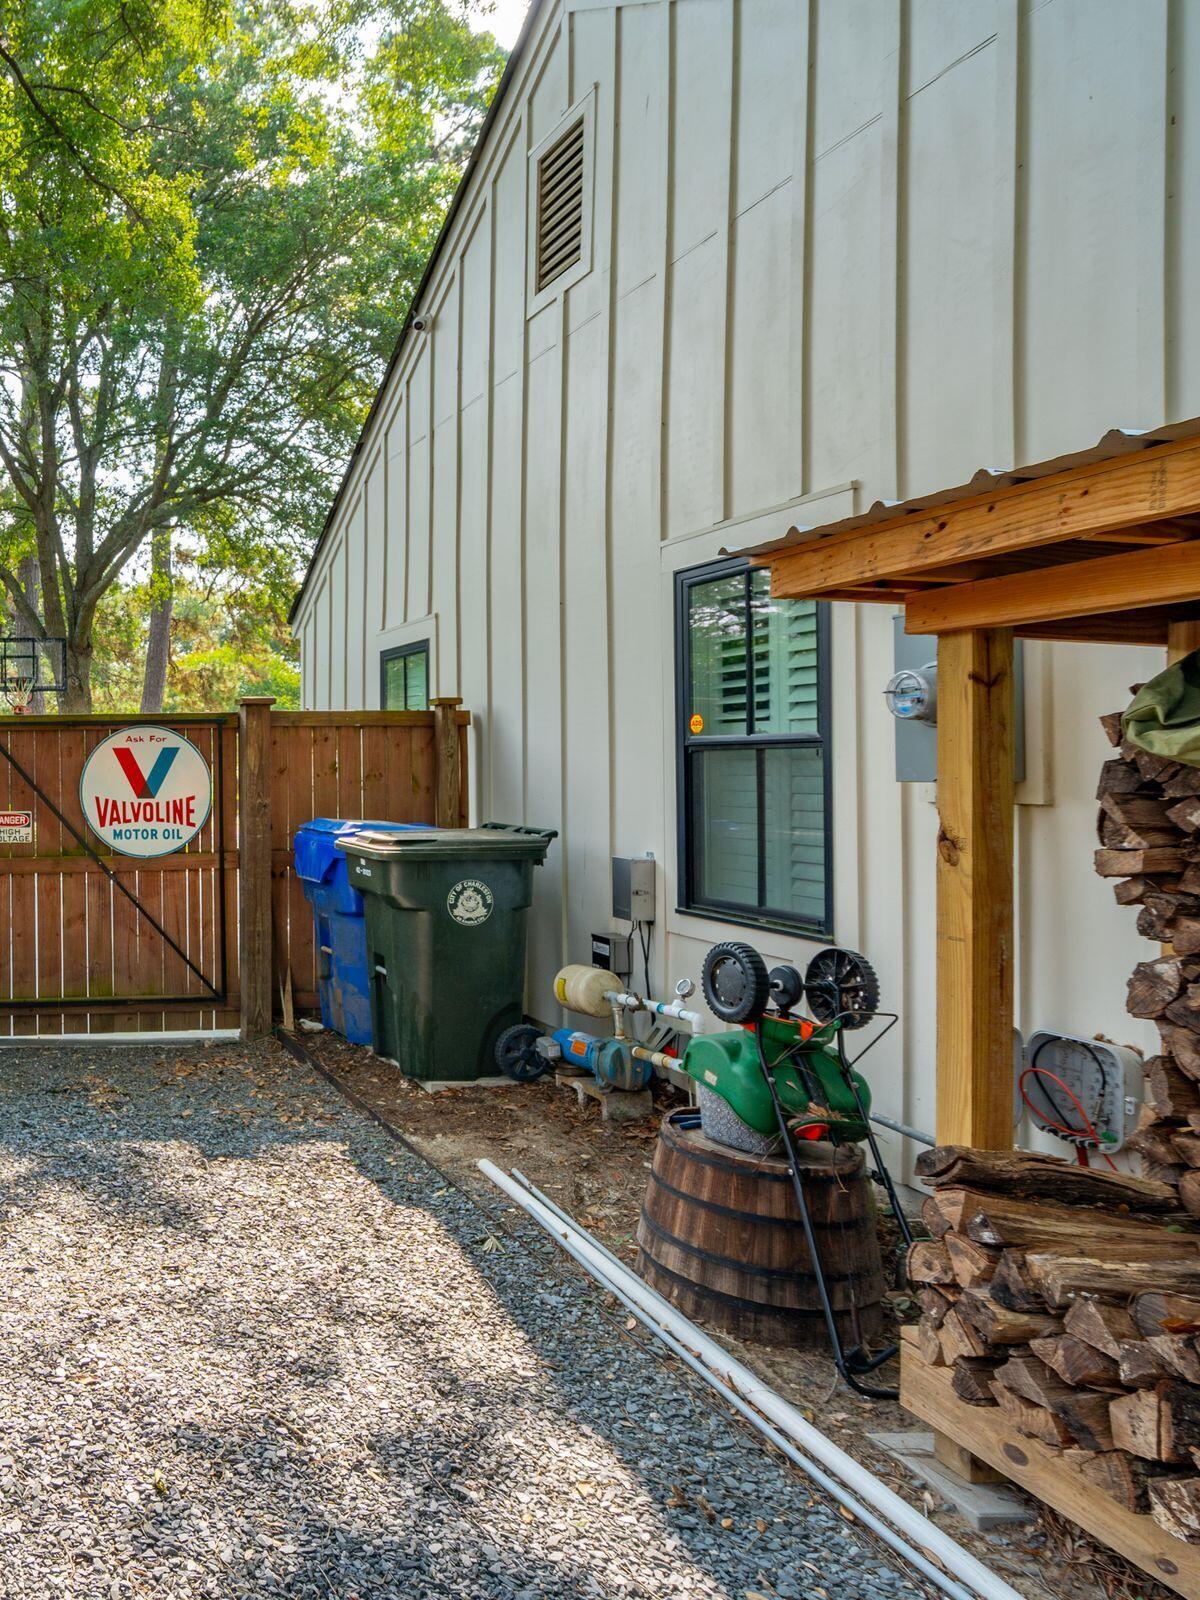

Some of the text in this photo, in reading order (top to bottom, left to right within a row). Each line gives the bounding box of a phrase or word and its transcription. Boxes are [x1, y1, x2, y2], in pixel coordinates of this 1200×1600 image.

[149, 735, 167, 743] For
[94, 795, 197, 828] VALVOLINE
[113, 828, 183, 840] MOTOR OIL
[449, 891, 457, 904] CITY
[455, 884, 463, 892] OF
